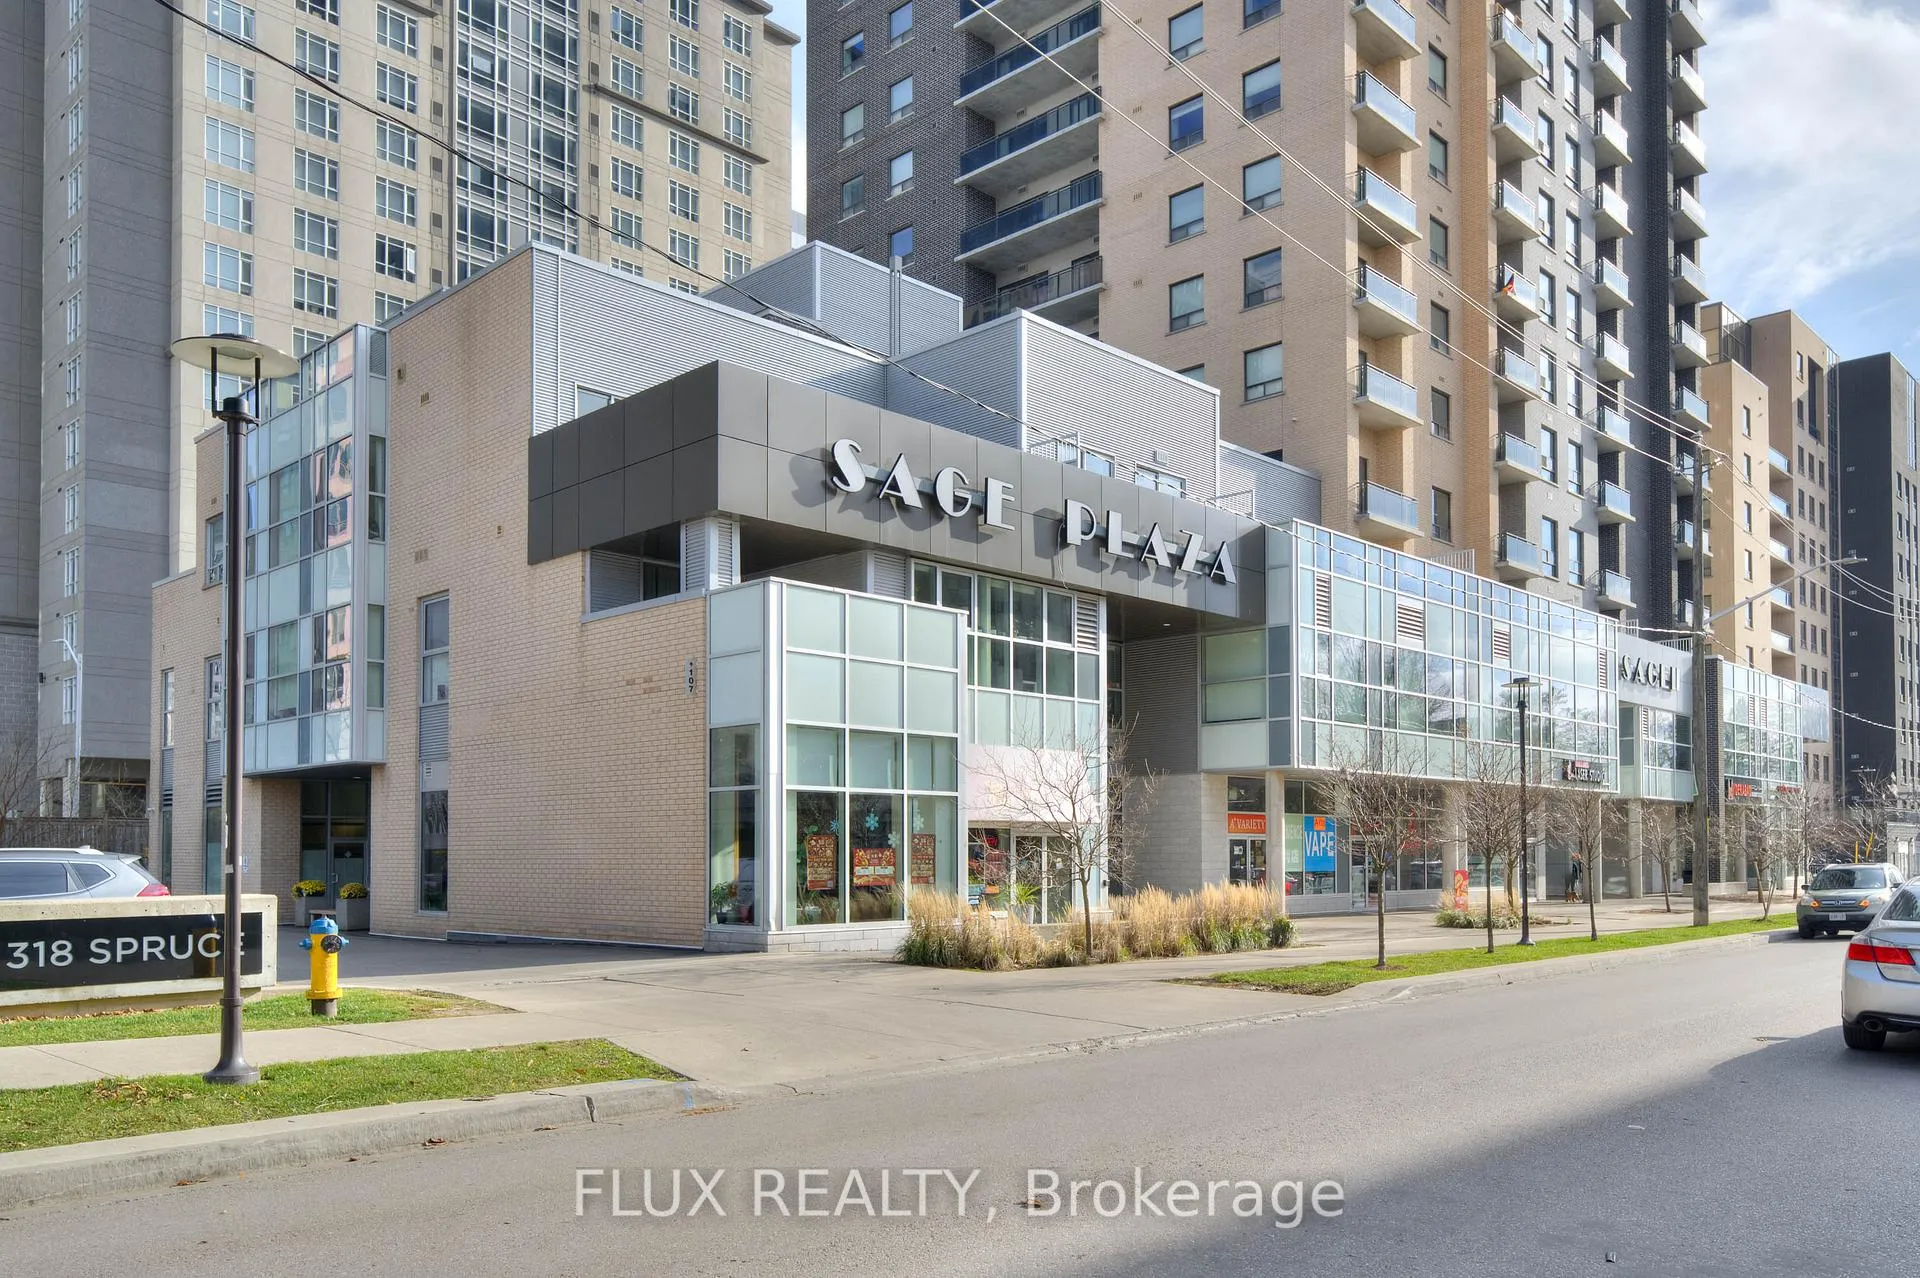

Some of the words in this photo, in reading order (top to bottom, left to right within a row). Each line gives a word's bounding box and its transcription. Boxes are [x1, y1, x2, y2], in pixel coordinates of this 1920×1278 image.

[831, 438, 1016, 532] SAGE
[1063, 498, 1237, 584] PLAZA
[1236, 818, 1265, 830] VARIETY
[1304, 831, 1335, 857] VAPE
[6, 939, 73, 969] 318
